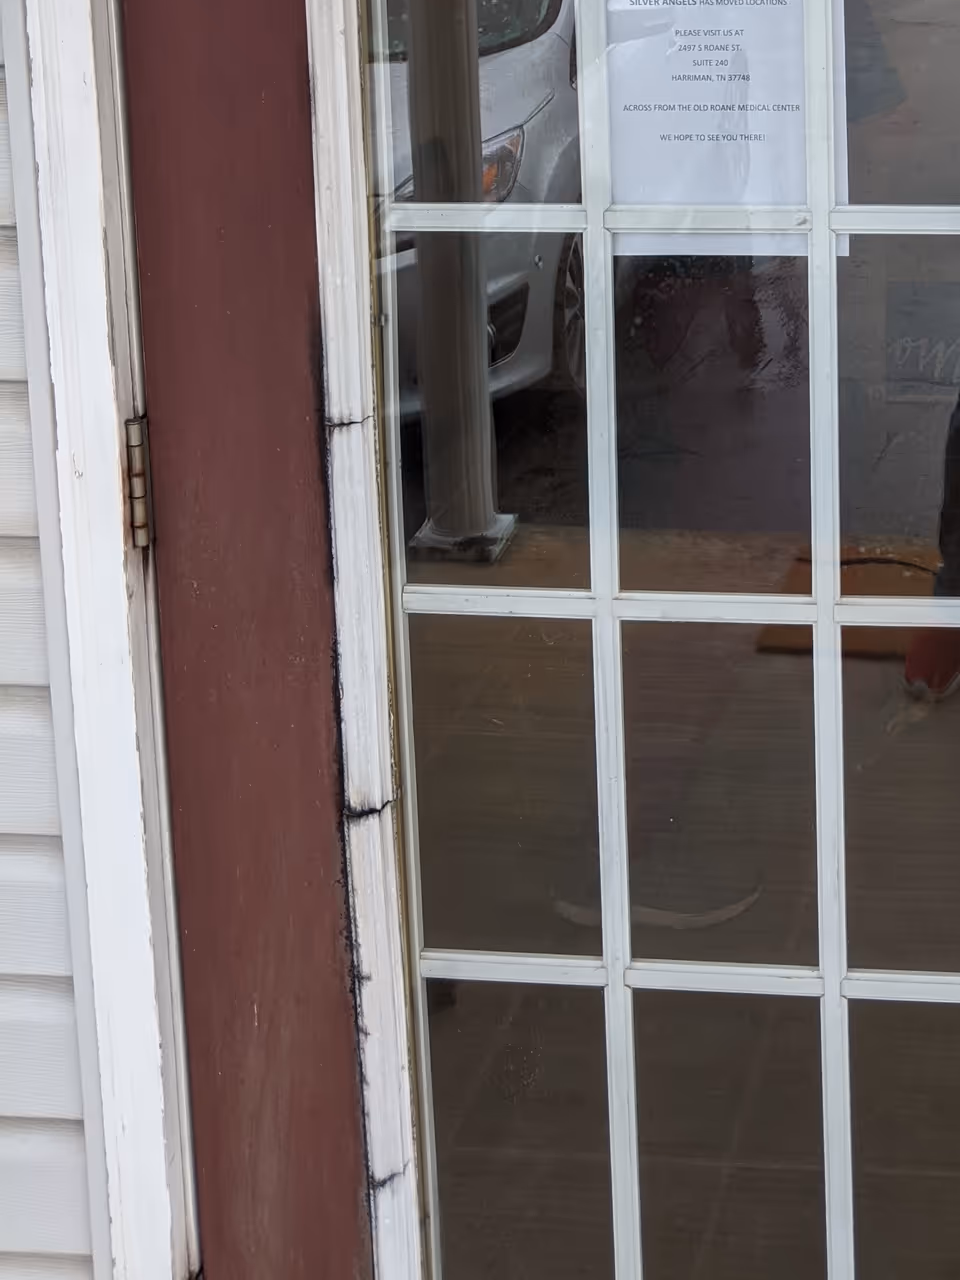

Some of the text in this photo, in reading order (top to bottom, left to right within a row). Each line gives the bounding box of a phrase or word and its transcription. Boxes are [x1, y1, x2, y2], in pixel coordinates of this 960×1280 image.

[675, 29, 744, 37] PLEASE VISIT US AT
[678, 44, 742, 52] 2497 S ROANE ST.
[693, 59, 728, 67] SUITE 240
[672, 74, 751, 83] HARRIMAN, TN 37748
[623, 104, 800, 112] ACROSS FROM THE OLD ROANE MEDICAL CENTER
